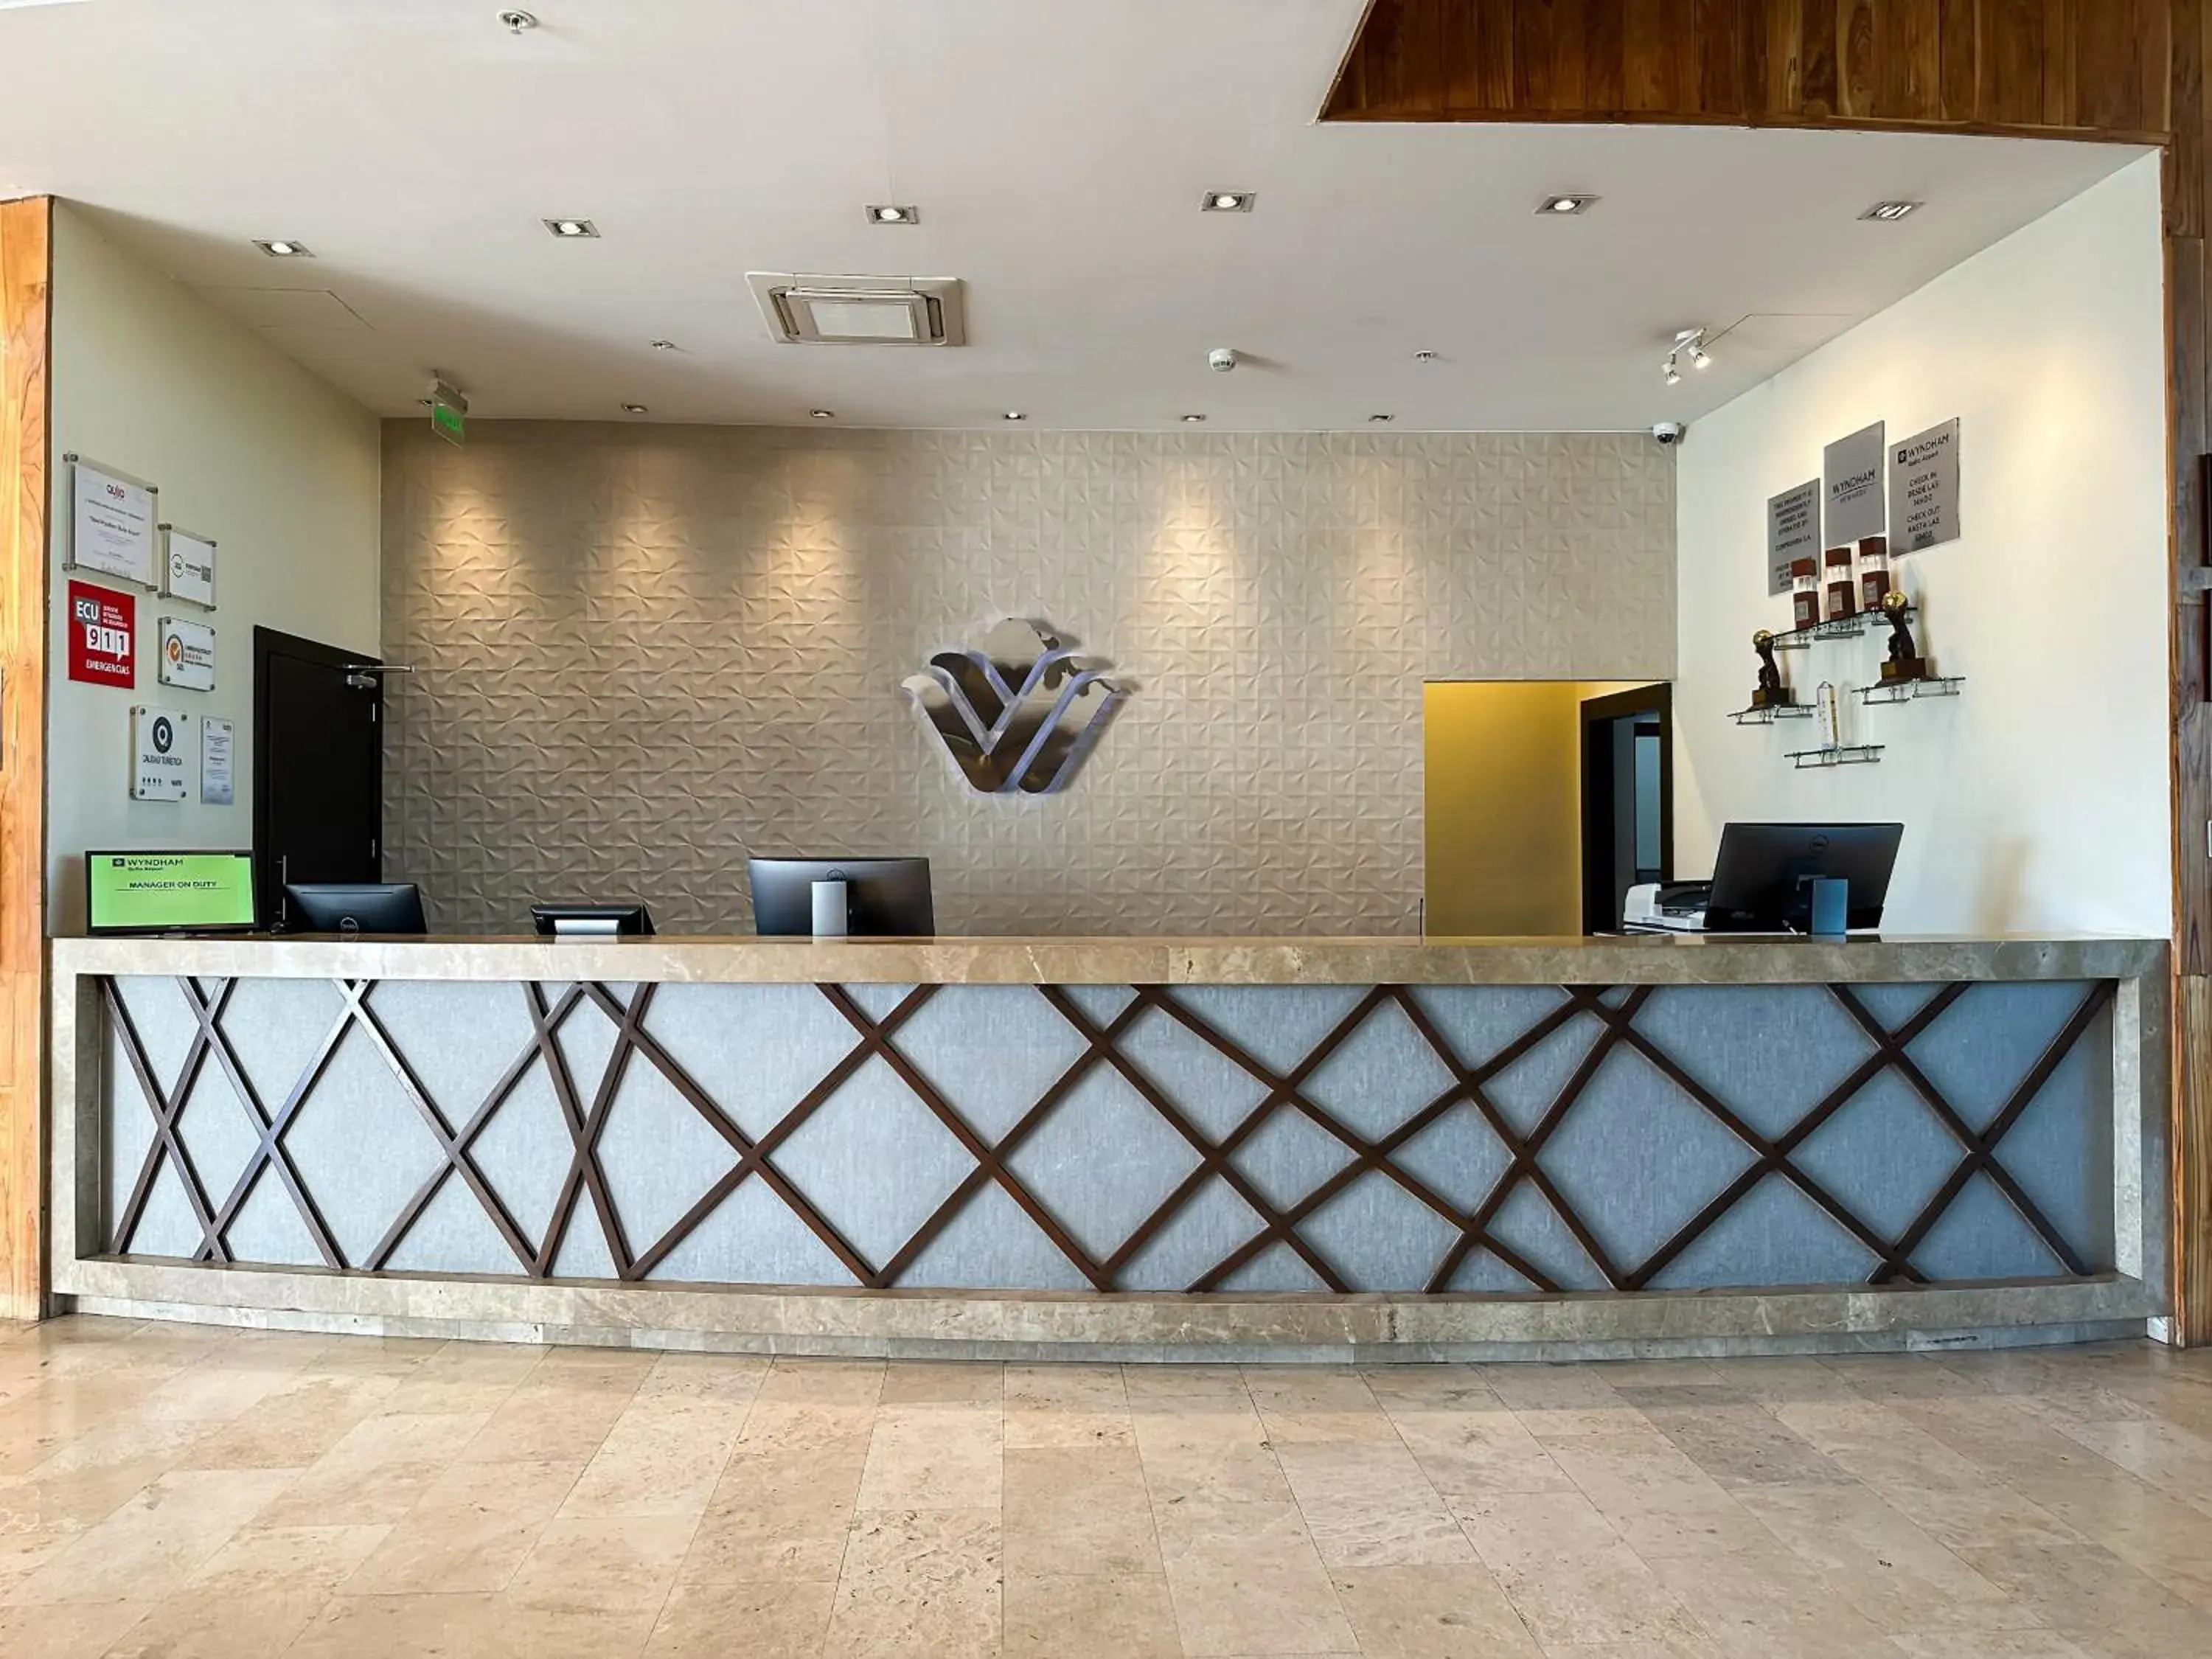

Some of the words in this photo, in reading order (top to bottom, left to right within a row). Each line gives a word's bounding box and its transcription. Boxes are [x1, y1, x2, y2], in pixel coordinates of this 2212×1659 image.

[1907, 433, 1949, 458] WYNDHAM
[1832, 468, 1875, 493] WYNDHAM
[76, 600, 98, 620] ECU
[89, 627, 125, 651] 911
[128, 858, 184, 866] WYNDHAM
[129, 880, 175, 888] MANAGER
[177, 880, 191, 888] ON
